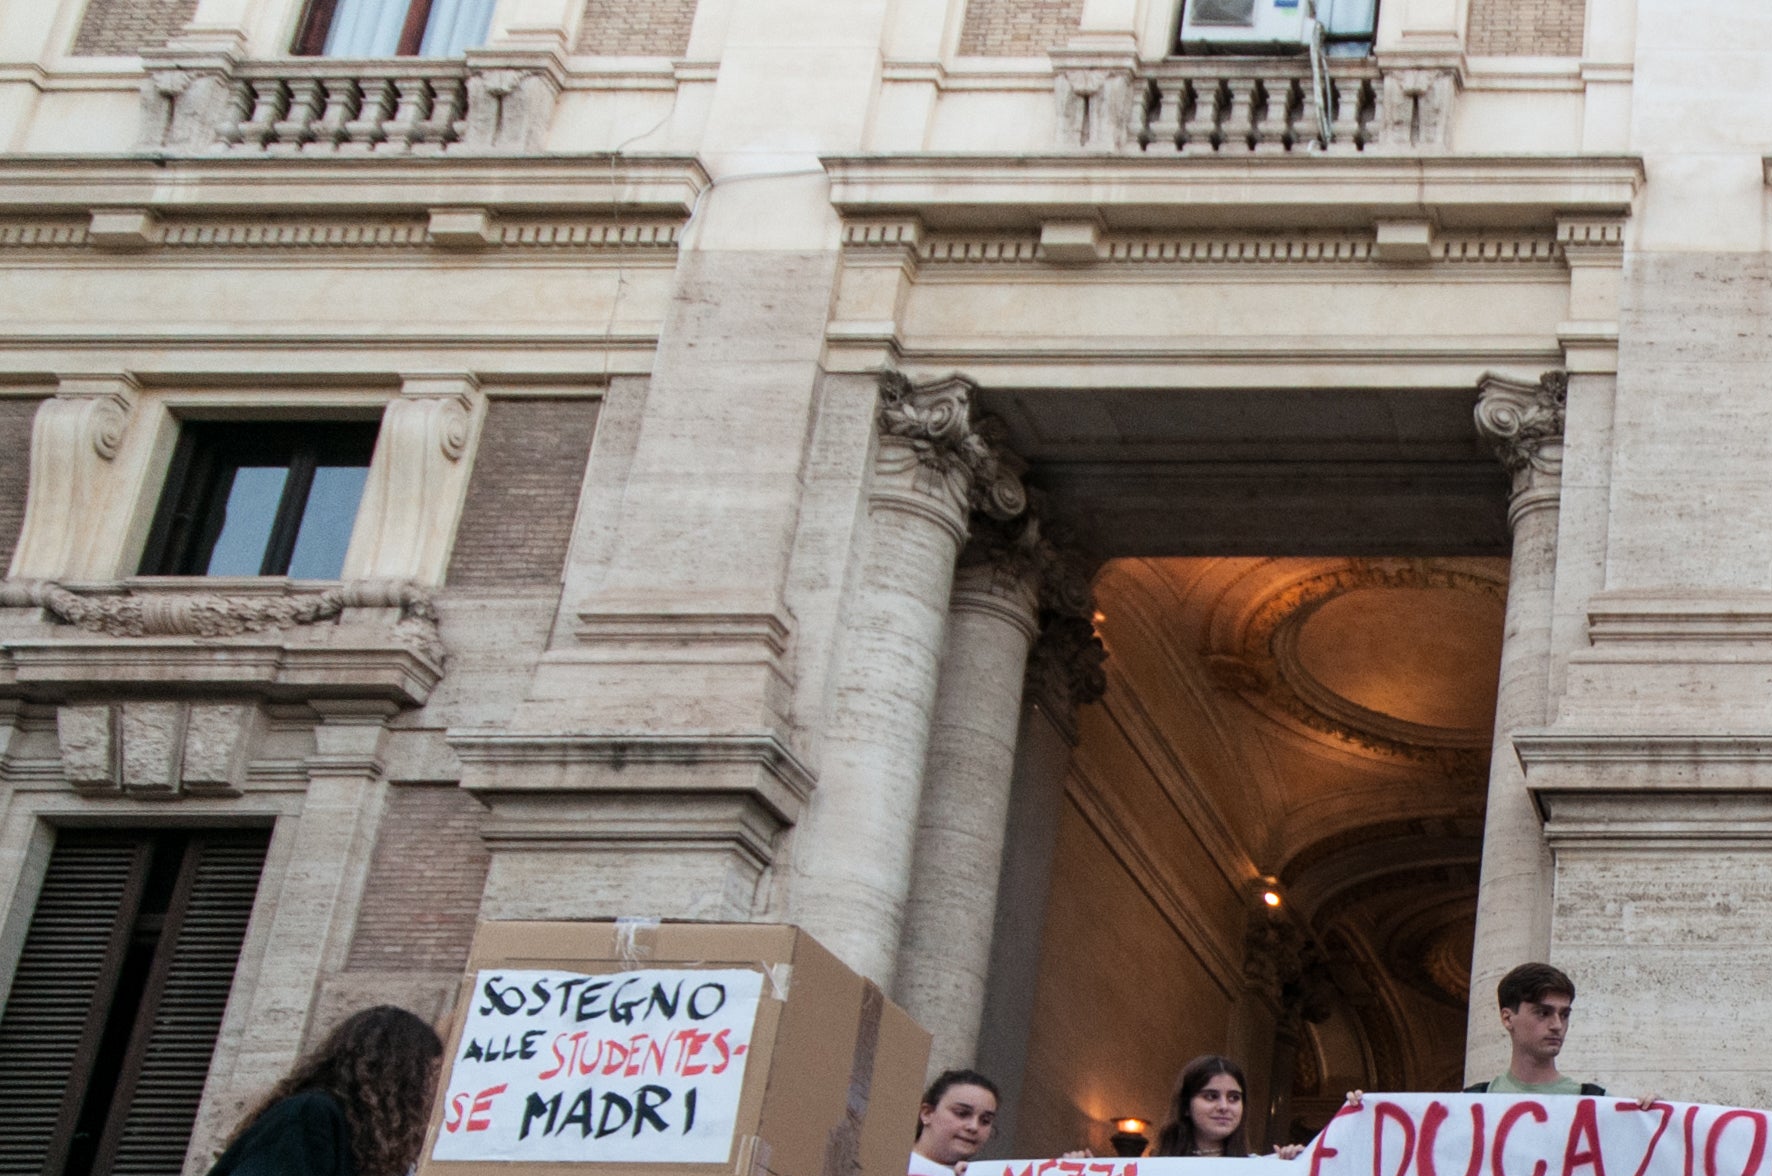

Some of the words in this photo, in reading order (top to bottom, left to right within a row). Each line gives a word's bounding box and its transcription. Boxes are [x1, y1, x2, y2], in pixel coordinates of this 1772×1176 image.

[479, 976, 726, 1026] SOSTEGNO
[463, 1030, 547, 1062] ALLE
[446, 1084, 507, 1133] SE
[519, 1084, 697, 1141] MADRI
